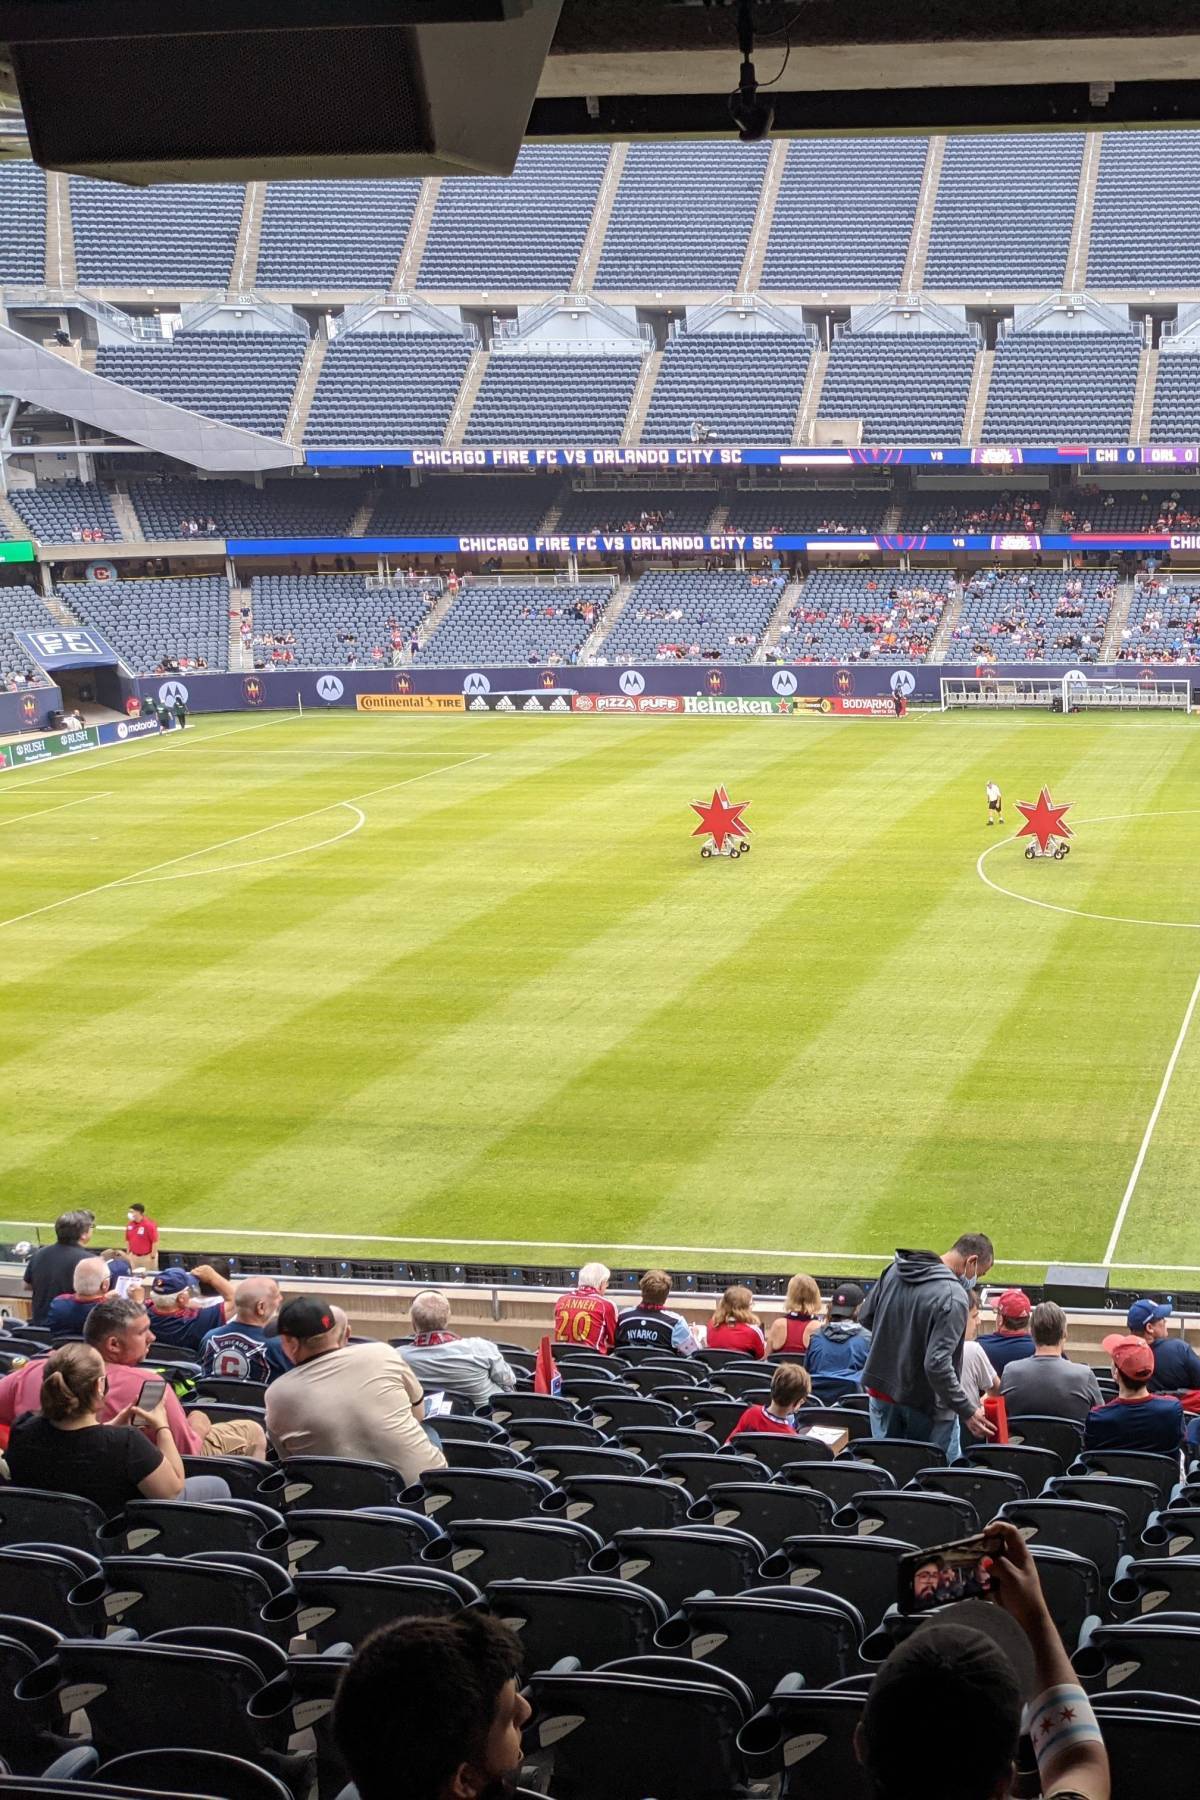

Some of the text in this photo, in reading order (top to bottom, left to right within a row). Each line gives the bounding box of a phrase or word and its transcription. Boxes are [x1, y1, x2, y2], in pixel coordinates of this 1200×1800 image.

[412, 450, 743, 465] CHICAGO FIRE FC VS ORLANDO CITY SC
[930, 451, 944, 461] VS
[1095, 448, 1135, 462] CHI 0
[1151, 448, 1193, 462] ORL 0
[459, 536, 774, 551] CHICAGO FIRE FC VS ORLANDO CITY SC
[360, 696, 462, 710] Continental TIRE
[597, 698, 635, 710] PIZZA
[639, 698, 679, 710] PUFF
[684, 696, 773, 714] Heineken
[128, 719, 158, 732] motorola
[67, 731, 88, 745] RUSH
[23, 740, 46, 754] RUSH
[556, 1311, 592, 1341] 20
[627, 1328, 659, 1342] NYARKO
[220, 1339, 249, 1351] CHICAGO
[220, 1356, 241, 1378] C
